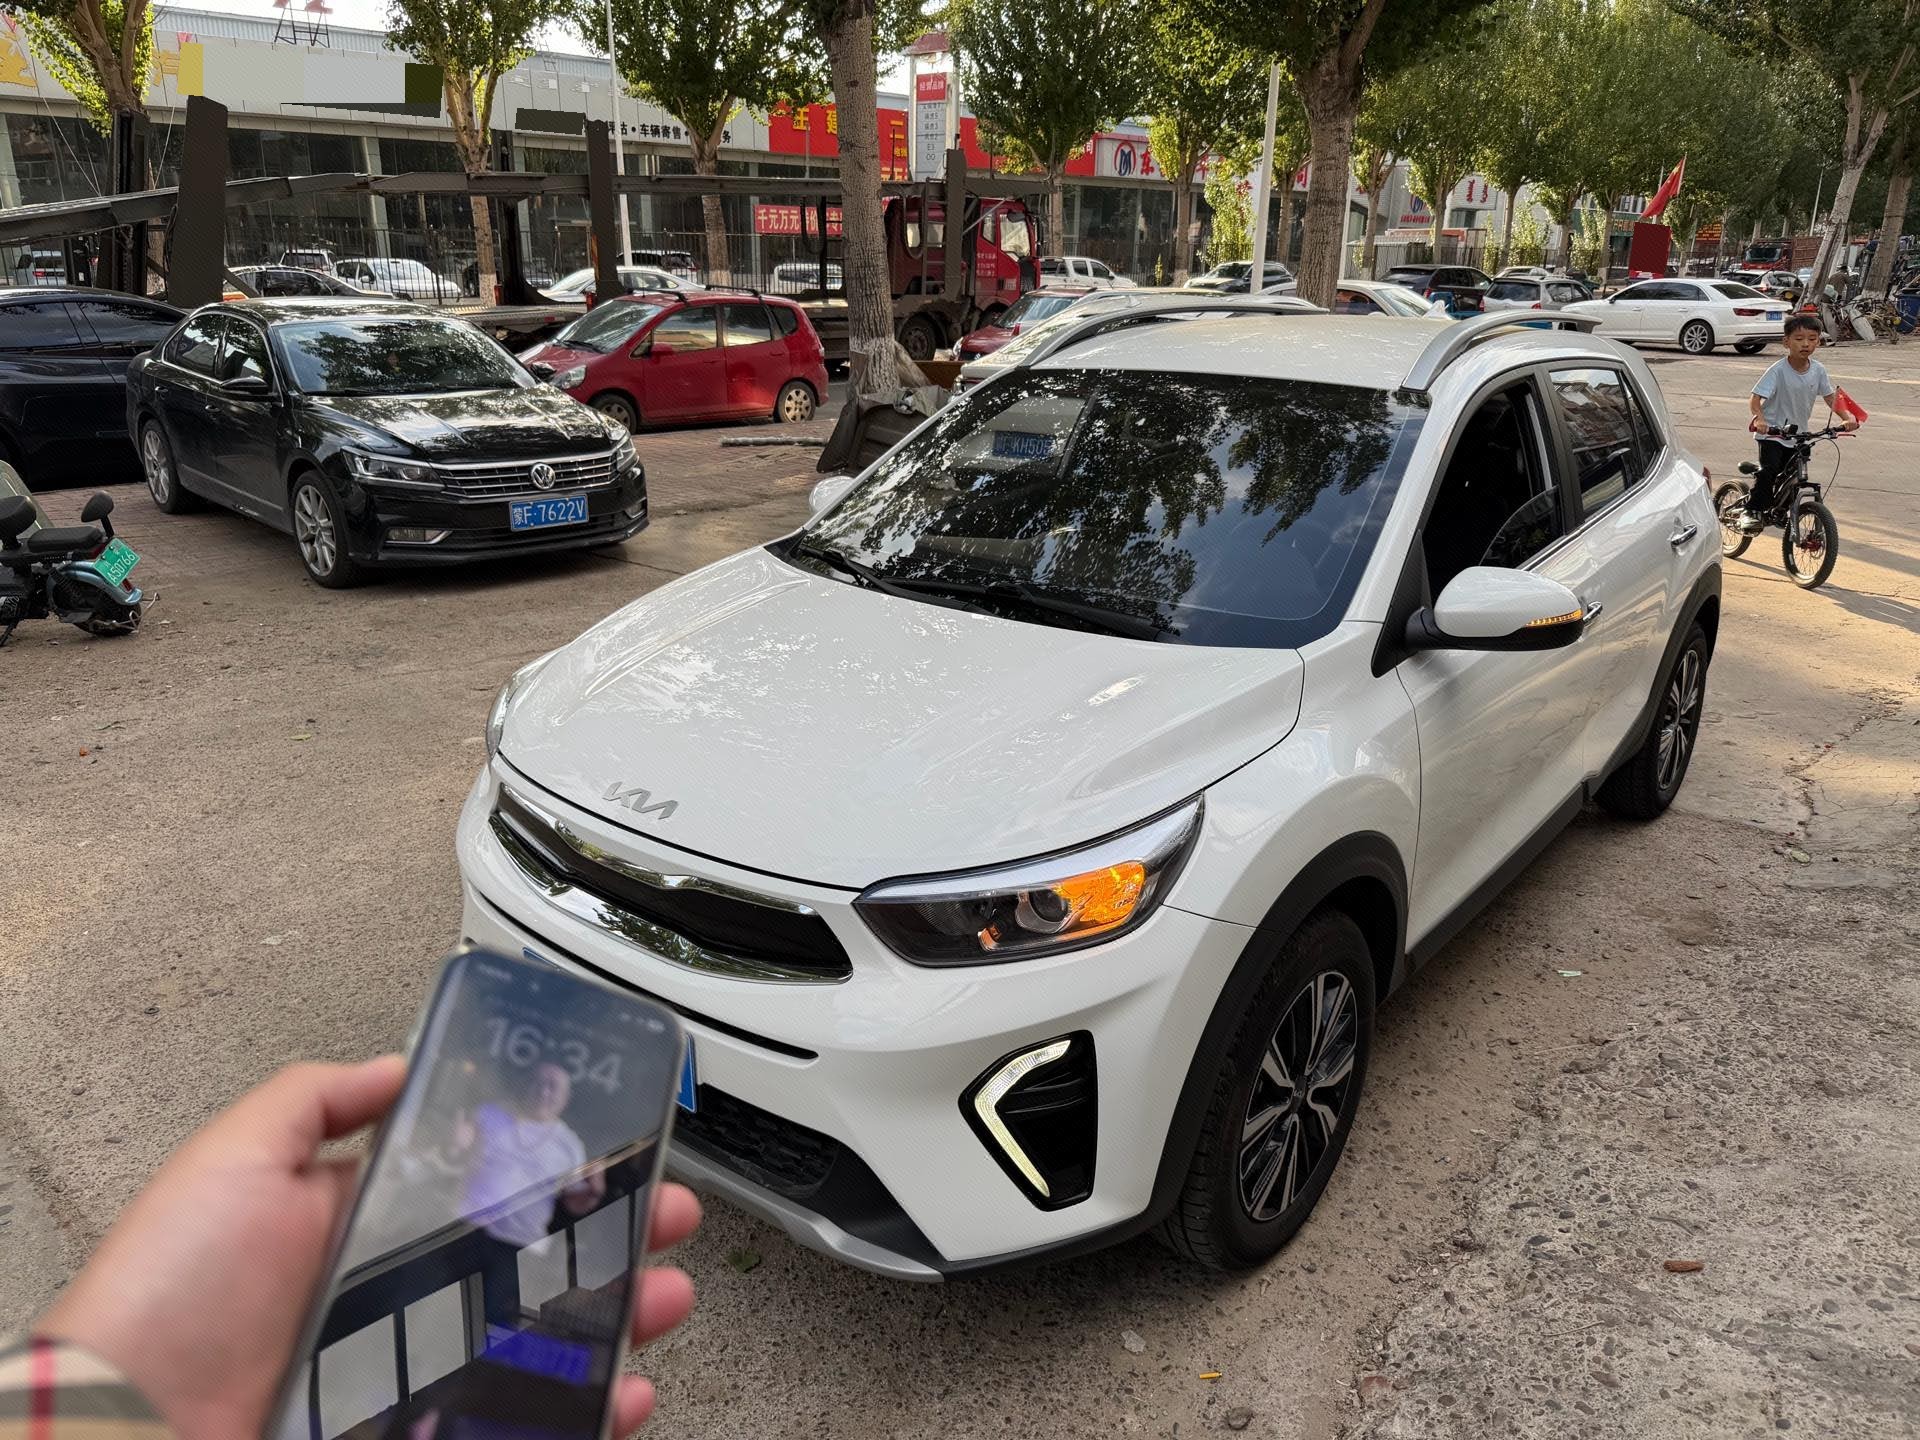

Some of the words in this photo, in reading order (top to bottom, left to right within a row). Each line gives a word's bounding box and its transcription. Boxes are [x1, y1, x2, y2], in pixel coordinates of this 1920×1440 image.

[107, 551, 135, 582] A50766
[602, 781, 678, 819] KIA
[485, 1016, 624, 1094] 16:34
